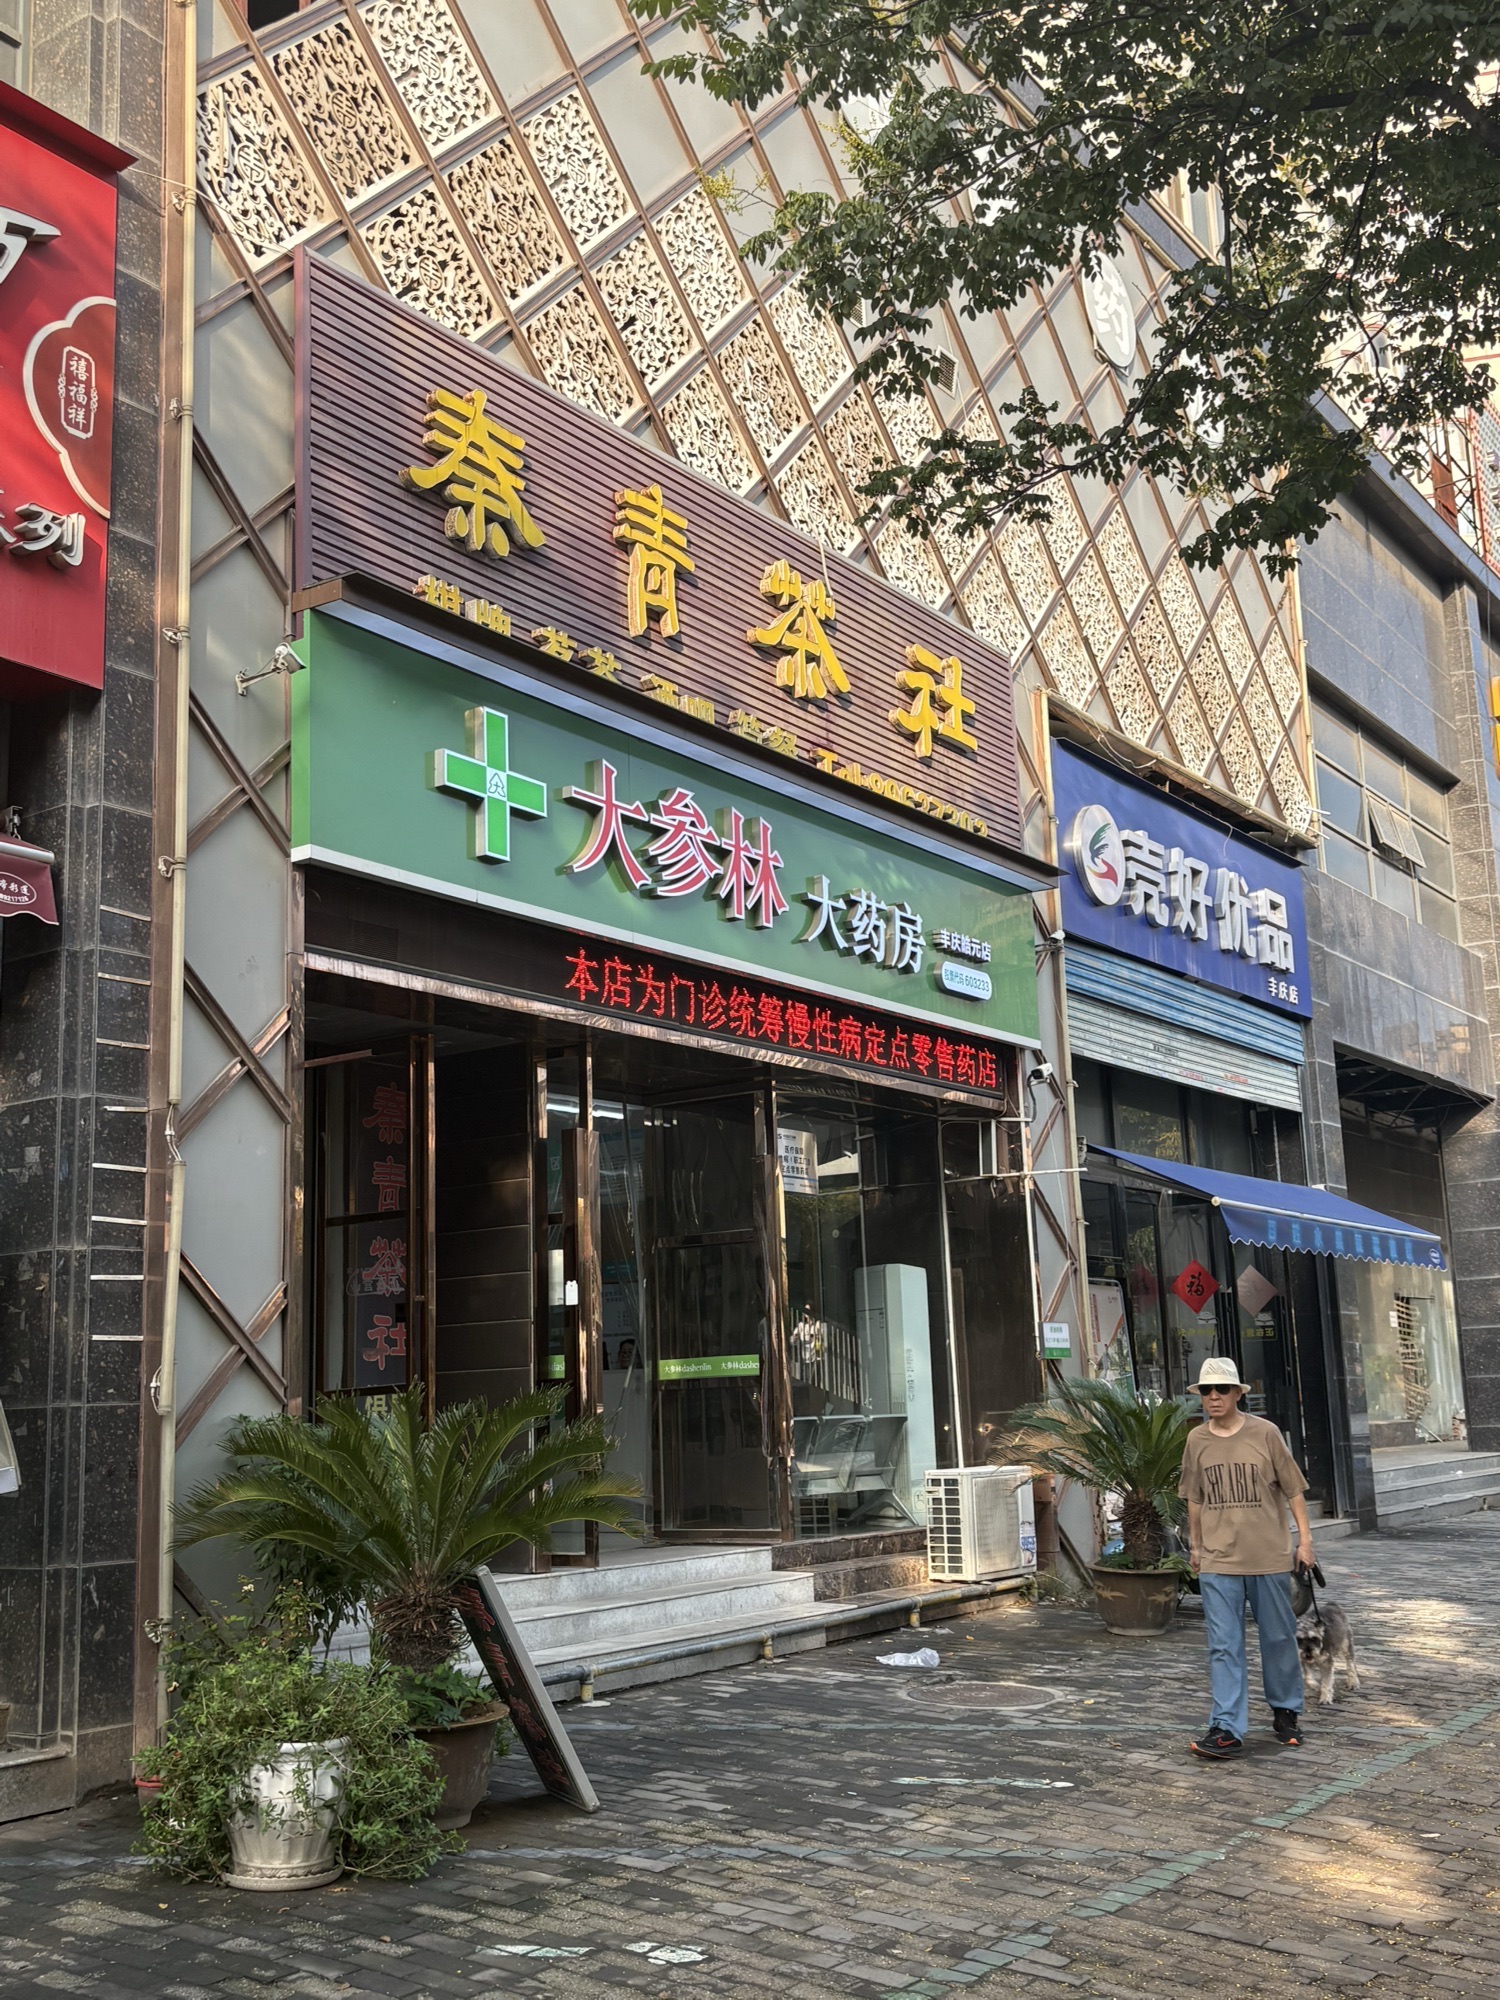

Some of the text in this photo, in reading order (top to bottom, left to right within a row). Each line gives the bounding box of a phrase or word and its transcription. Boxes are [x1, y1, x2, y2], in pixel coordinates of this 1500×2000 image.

[67, 355, 90, 431] 禧福祥
[0, 488, 86, 569] 列
[400, 387, 979, 760] 秦青茶社
[563, 758, 790, 930] 大参林
[801, 874, 927, 975] 大药房
[564, 946, 998, 1089] 本店为门诊统筹慢性病定点零售药店
[1267, 976, 1299, 1005] 丰庆店
[1185, 1271, 1205, 1297] 福
